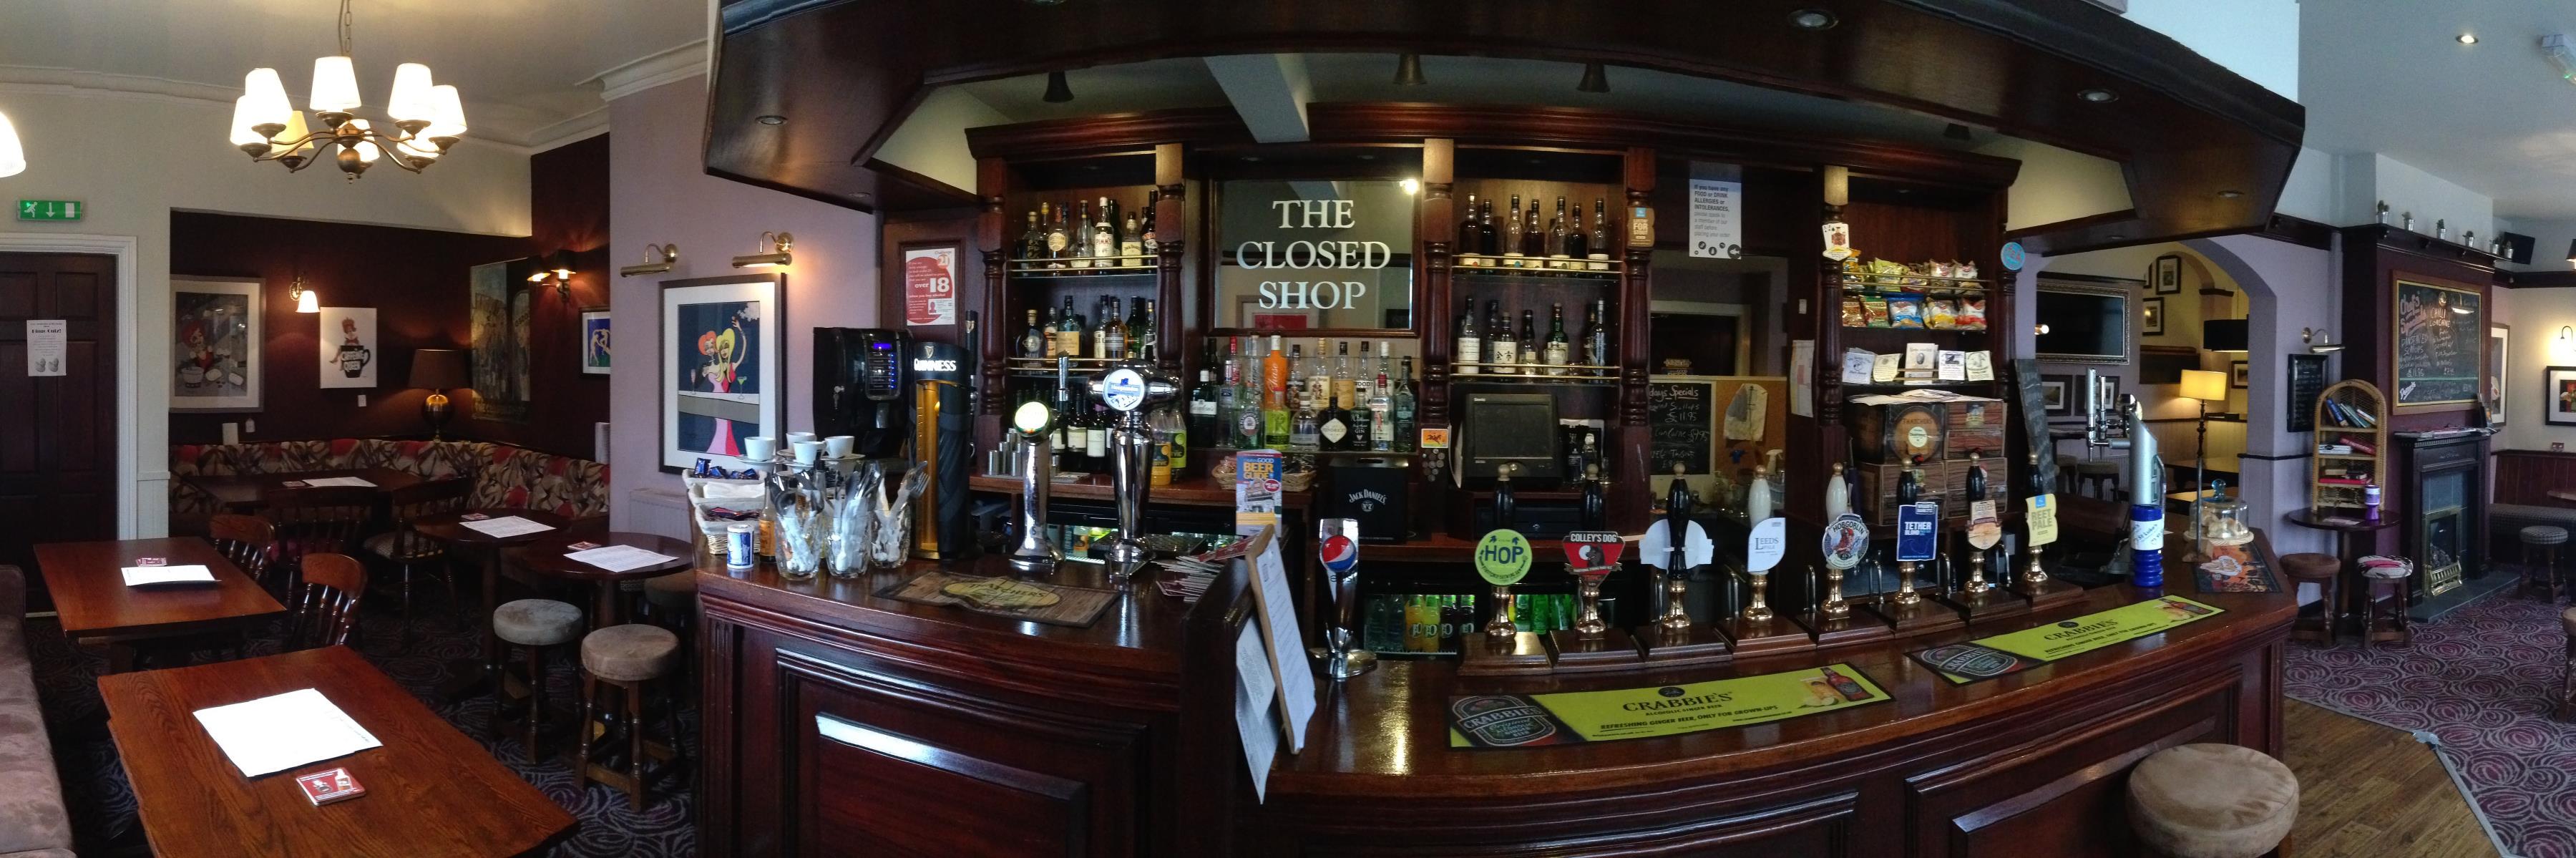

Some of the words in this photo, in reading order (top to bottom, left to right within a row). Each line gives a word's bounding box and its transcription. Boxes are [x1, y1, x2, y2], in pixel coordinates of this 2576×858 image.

[1272, 200, 1356, 228] THE
[1236, 240, 1391, 269] CLOSED
[930, 277, 950, 293] 18
[1259, 281, 1366, 310] SHOP
[914, 358, 957, 371] GUINNESS
[1669, 385, 1699, 400] Specials
[1243, 462, 1274, 472] BEER
[1348, 492, 1364, 503] JACK
[1363, 489, 1387, 505] DANIEL'S
[1833, 521, 1865, 535] HOBGOBLIN
[1904, 522, 1932, 530] TETHER
[2031, 518, 2053, 531] PALE
[1570, 533, 1602, 542] COLLEY'S
[1602, 534, 1617, 542] DOG
[1755, 537, 1779, 550] LEEDS
[1484, 545, 1524, 564] HOP
[2044, 619, 2118, 640] CRABBIE'S
[1623, 692, 1732, 711] CRABBIE'S
[1601, 720, 1648, 729] REFRESHING
[1734, 705, 1778, 715] GROWN-UPS
